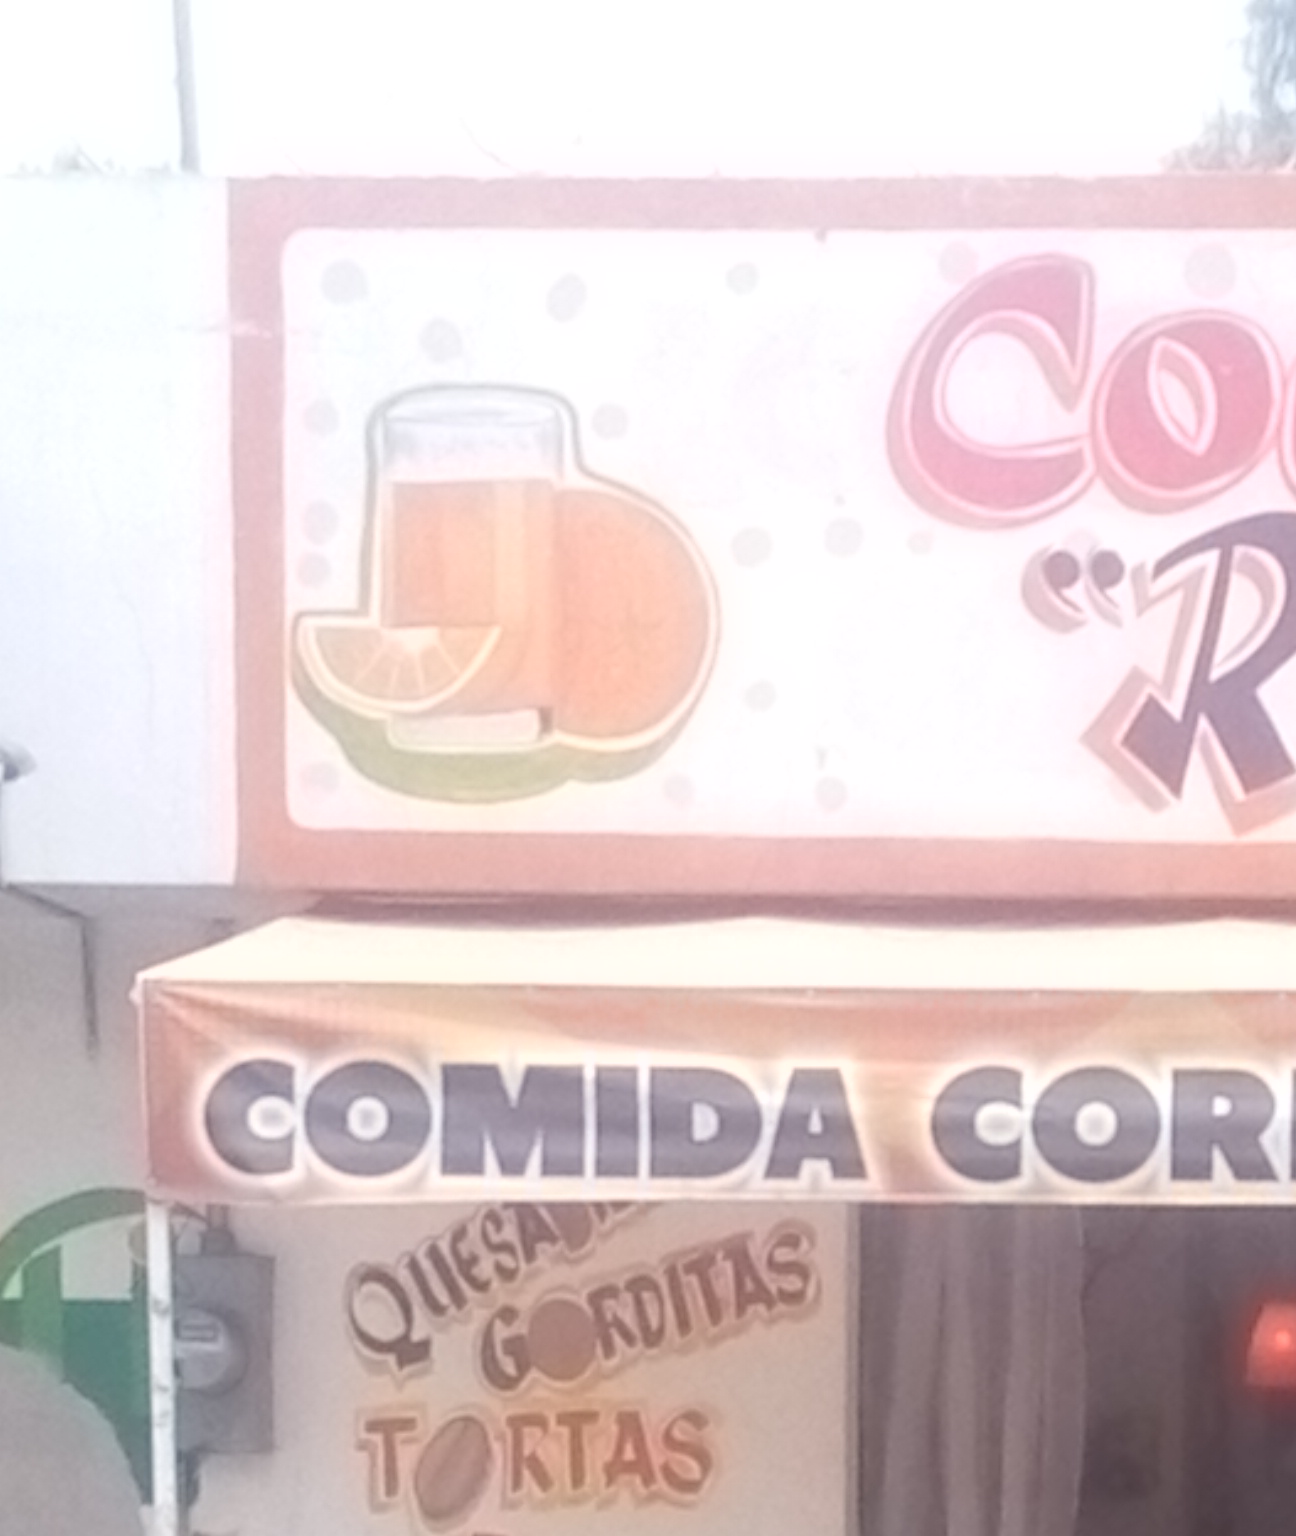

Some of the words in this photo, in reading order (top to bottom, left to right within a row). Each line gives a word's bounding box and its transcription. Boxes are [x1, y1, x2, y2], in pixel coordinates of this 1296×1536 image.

[203, 1057, 869, 1180] COMIDA
[480, 1231, 812, 1392] GORDITAS
[364, 1409, 713, 1522] TORTAS
